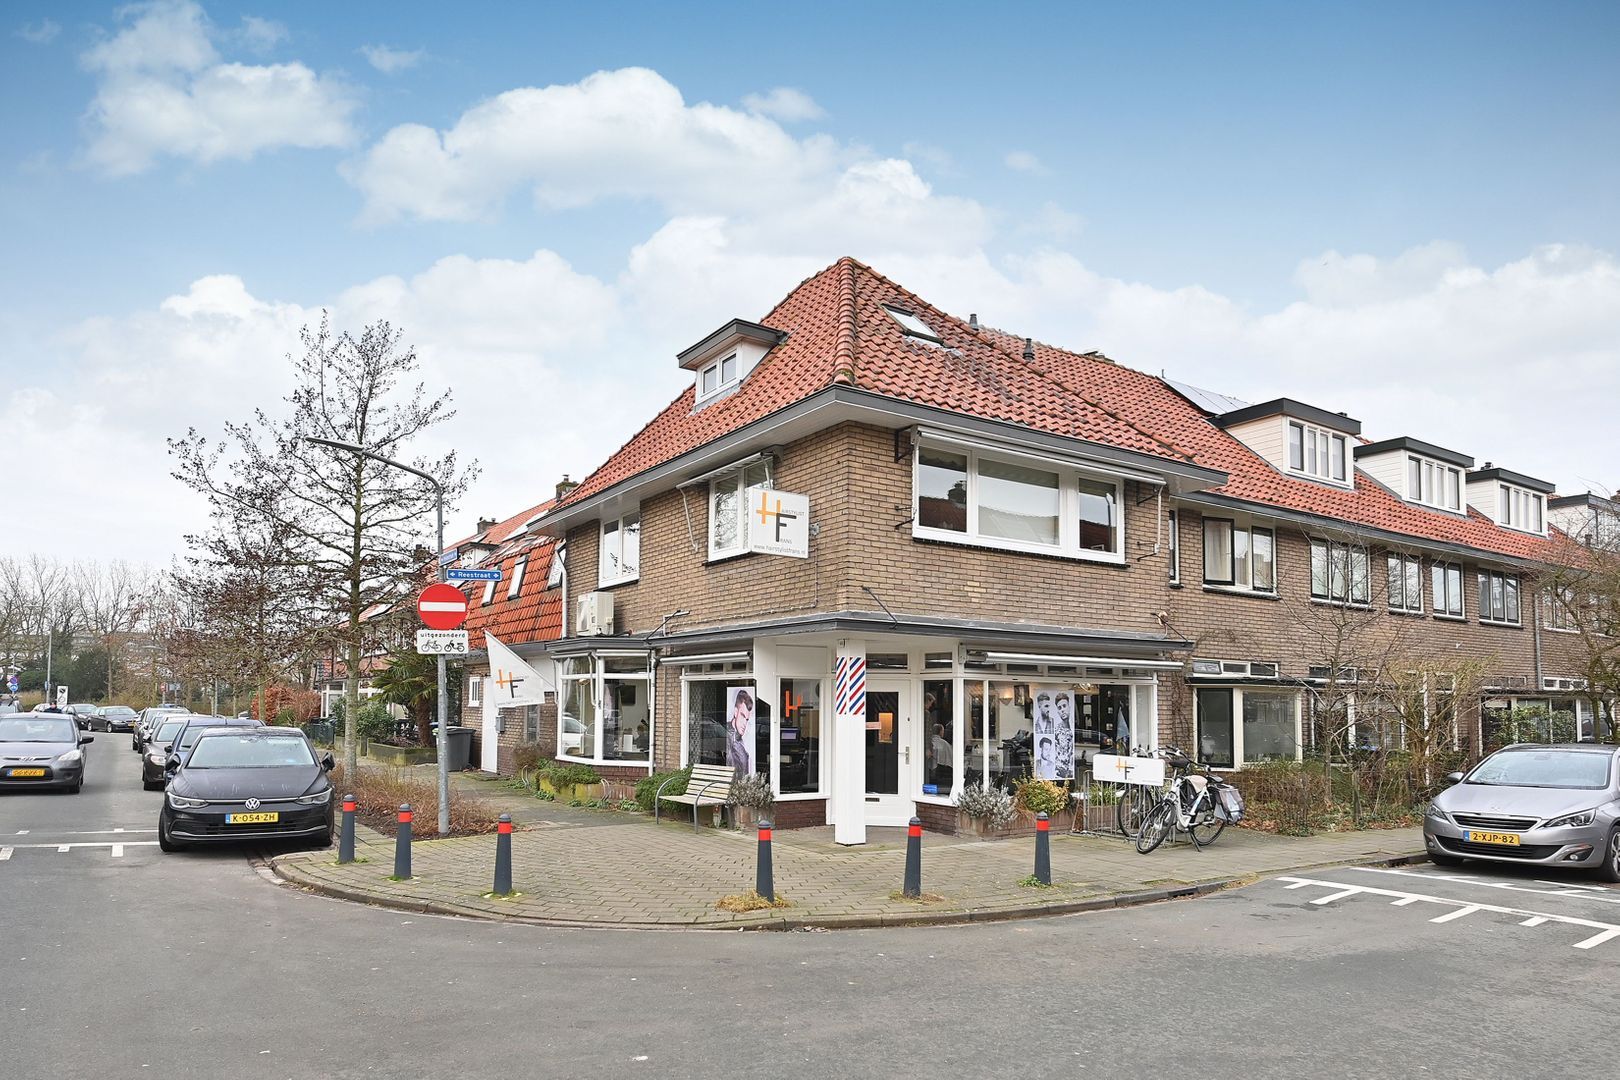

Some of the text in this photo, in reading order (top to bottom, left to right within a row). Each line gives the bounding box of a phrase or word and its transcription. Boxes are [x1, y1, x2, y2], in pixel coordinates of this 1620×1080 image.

[458, 571, 491, 579] Reestraat
[232, 813, 275, 822] K-054-ZH
[1473, 832, 1514, 844] 2-XJP-82
